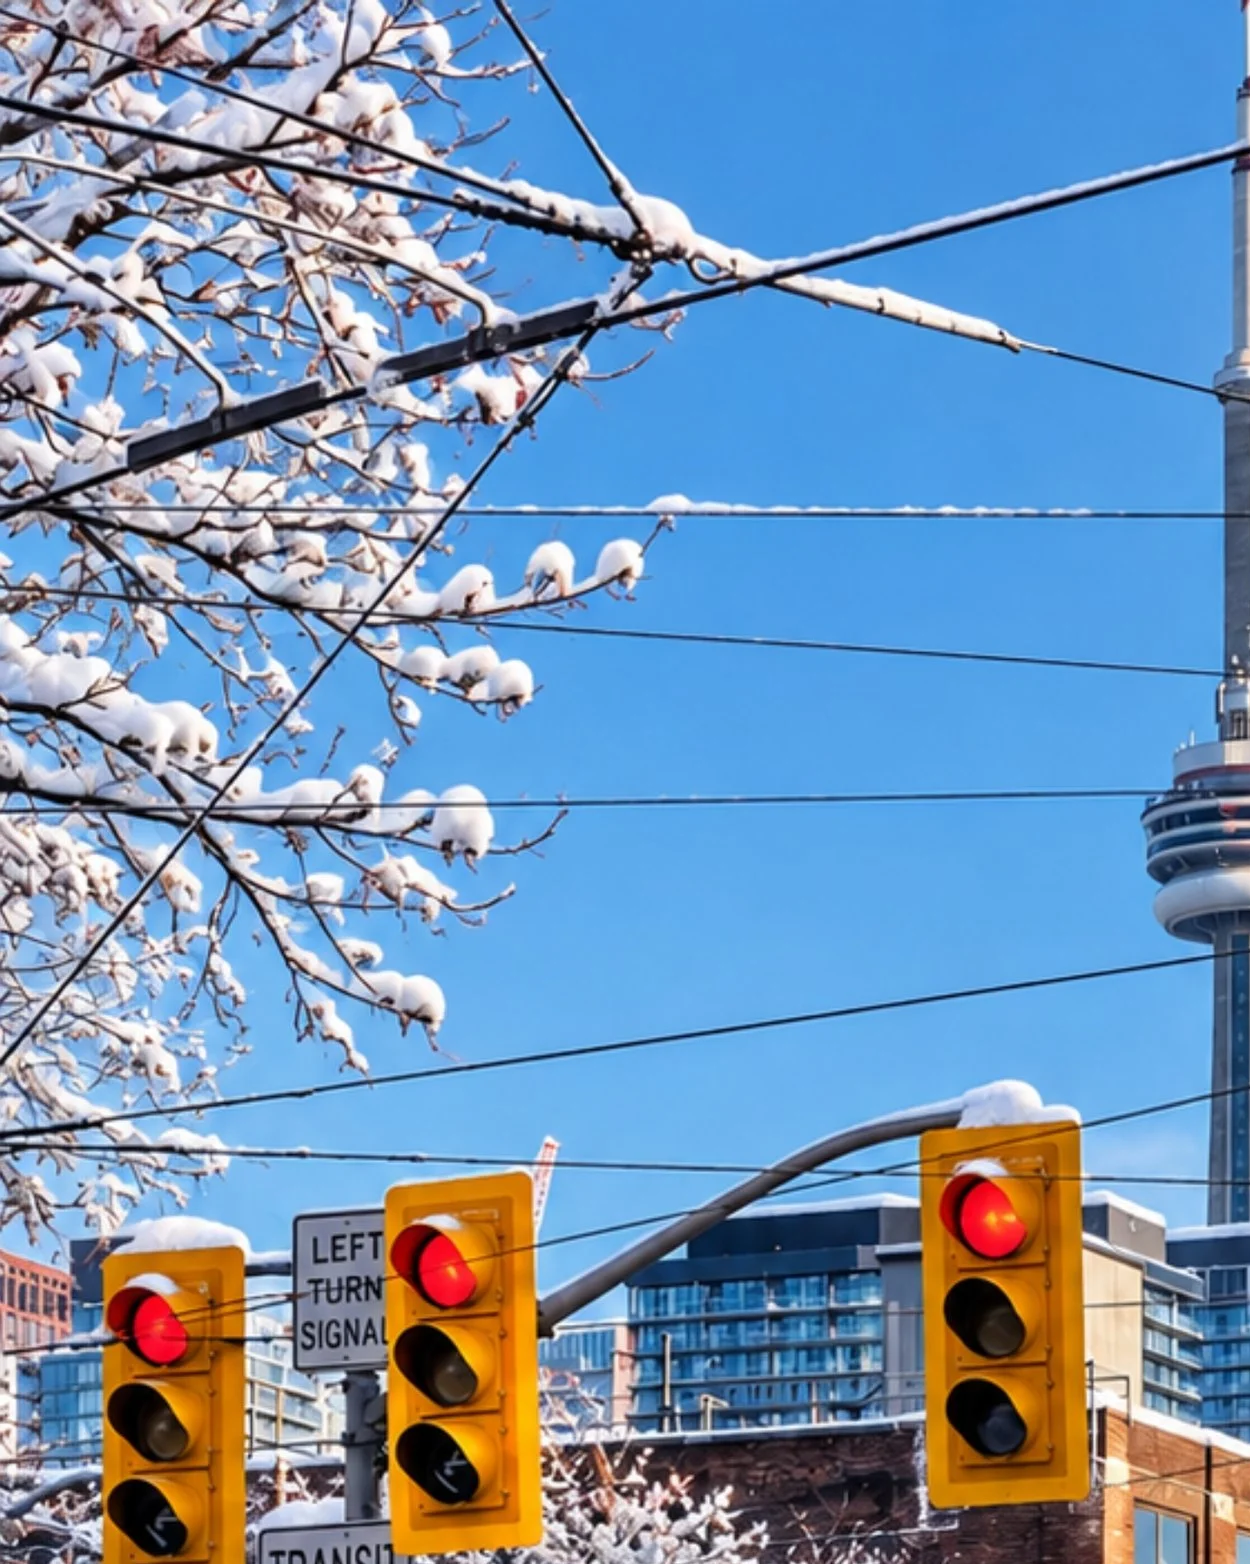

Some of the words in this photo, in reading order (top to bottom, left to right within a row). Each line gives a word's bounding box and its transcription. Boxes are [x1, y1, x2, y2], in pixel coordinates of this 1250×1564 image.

[311, 1230, 385, 1265] LEFT
[306, 1275, 384, 1306] TURN
[300, 1315, 389, 1352] SIGNAL
